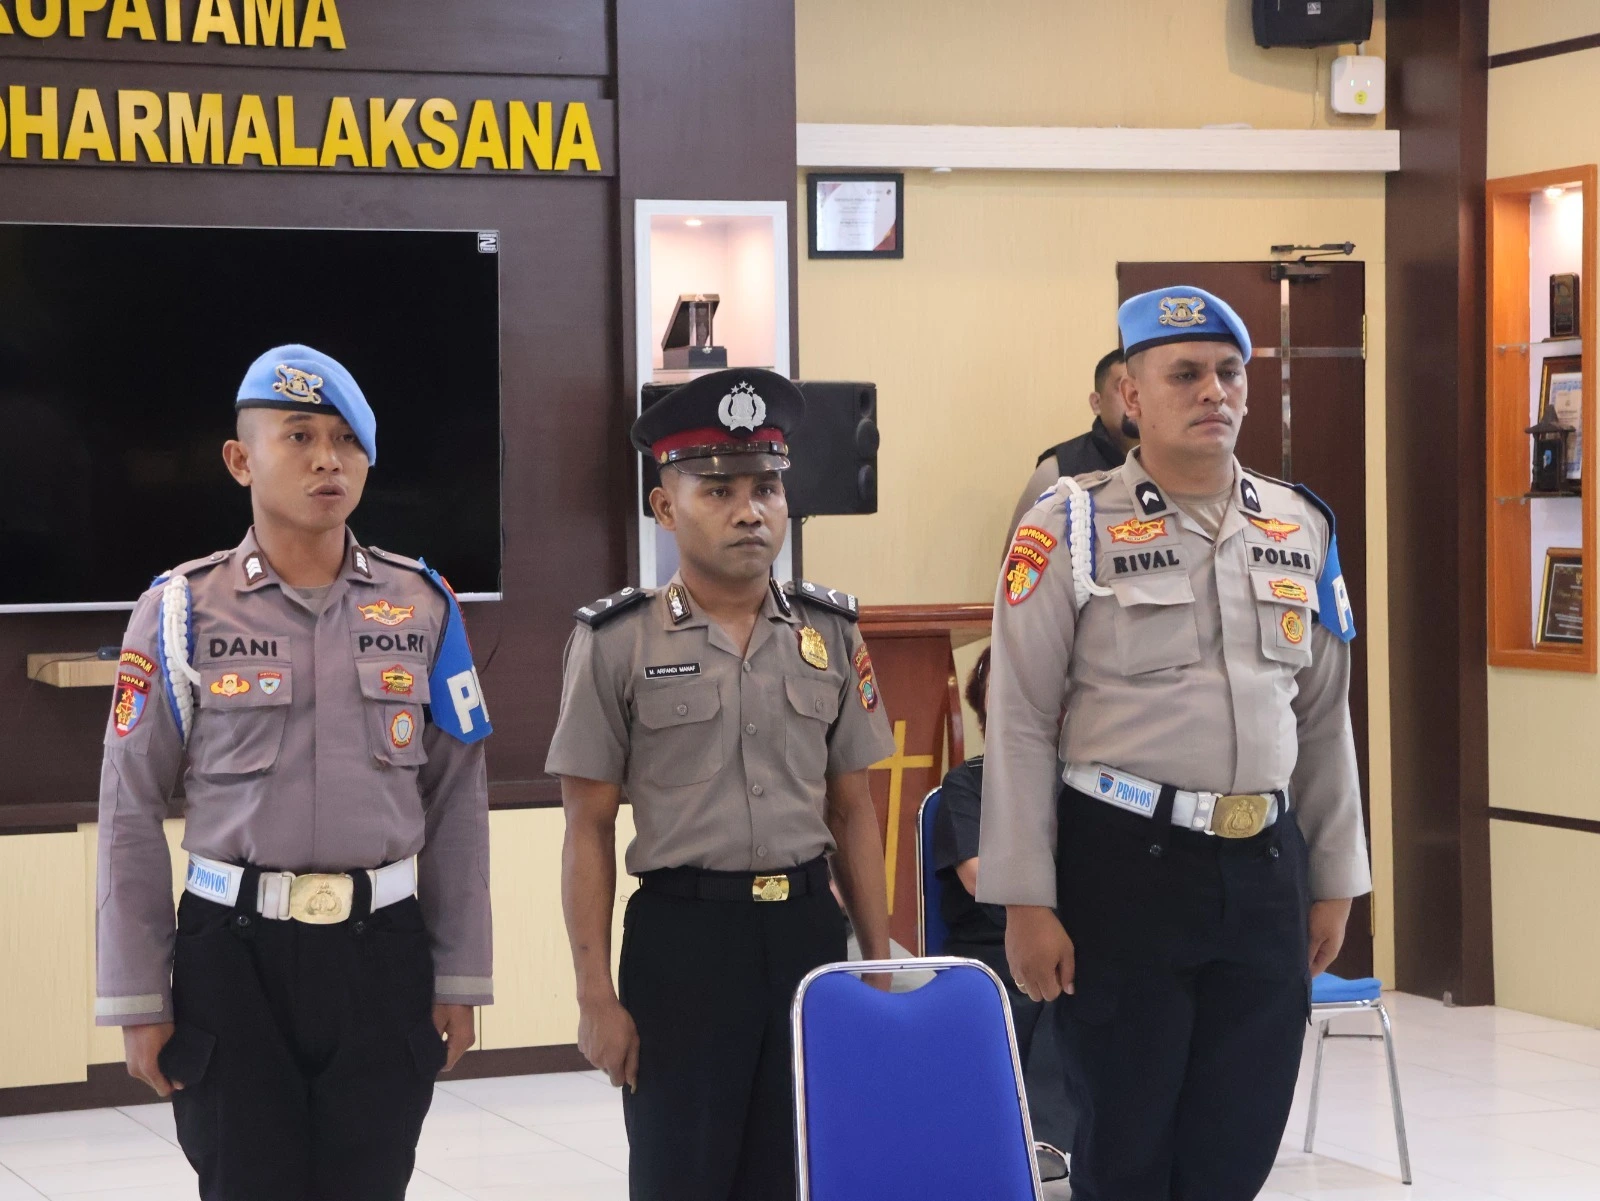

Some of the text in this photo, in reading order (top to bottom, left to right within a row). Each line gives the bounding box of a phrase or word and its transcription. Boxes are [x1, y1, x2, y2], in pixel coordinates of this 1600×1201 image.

[0, 0, 347, 50] UPATAMA
[0, 85, 602, 171] HARMALAKSANA
[1013, 545, 1045, 565] PROPAM
[1113, 550, 1180, 574] RIVAL
[1252, 546, 1311, 570] POLRI
[209, 637, 277, 658] DANI
[359, 633, 424, 653] POLRI
[1115, 781, 1152, 808] PROVOS
[194, 866, 227, 894] PROVOS
